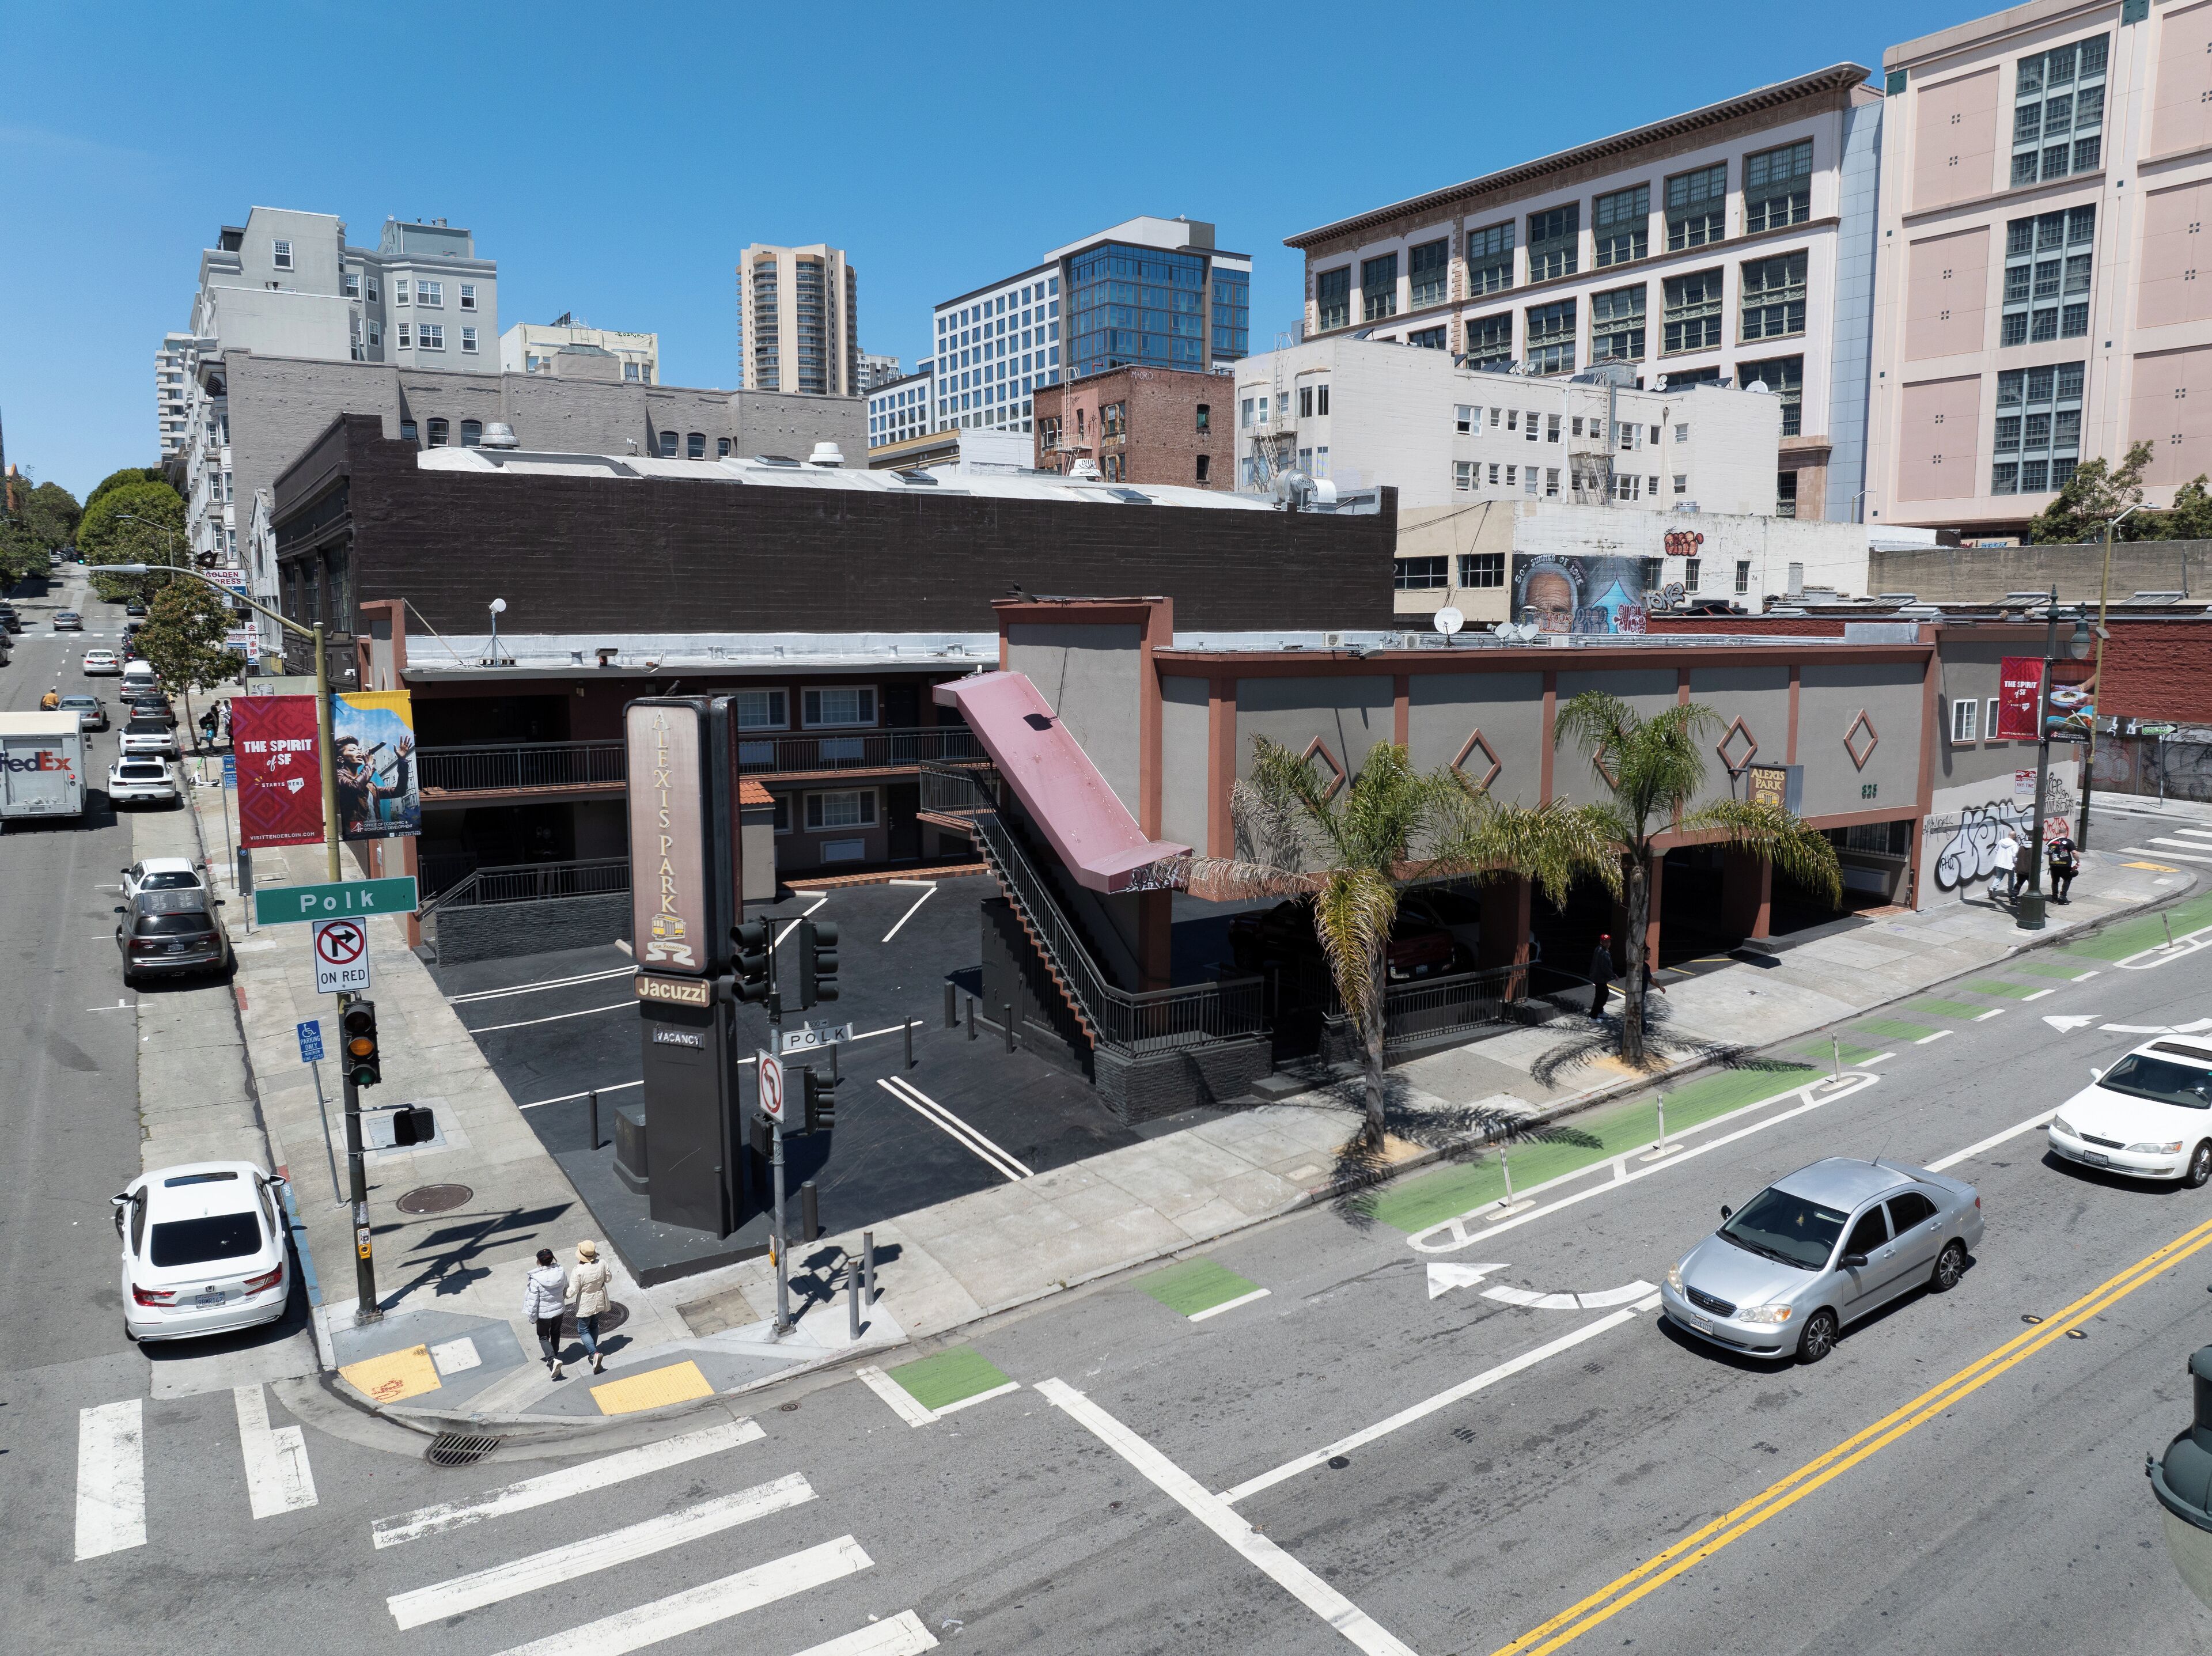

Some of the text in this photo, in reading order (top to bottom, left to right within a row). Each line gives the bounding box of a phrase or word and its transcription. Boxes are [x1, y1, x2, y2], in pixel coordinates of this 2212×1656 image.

[1131, 371, 1153, 380] MACRO
[1531, 554, 1556, 567] SUMMER
[1569, 564, 1584, 586] LOVE
[2014, 689, 2020, 698] of
[243, 739, 312, 753] THE SPIRIT
[267, 753, 291, 771] of SF
[1751, 768, 1785, 780] ALEXIS
[1755, 778, 1782, 790] PARK
[652, 708, 679, 914] ALEXIS PARK
[250, 832, 315, 840] VISITTENDERLOIN.COM
[300, 890, 374, 913] Polk
[321, 969, 365, 984] ON RED
[639, 977, 706, 1002] Jacuzzi
[300, 1035, 320, 1045] PARKING
[657, 1032, 699, 1045] VACANCY
[791, 1028, 845, 1047] POLK
